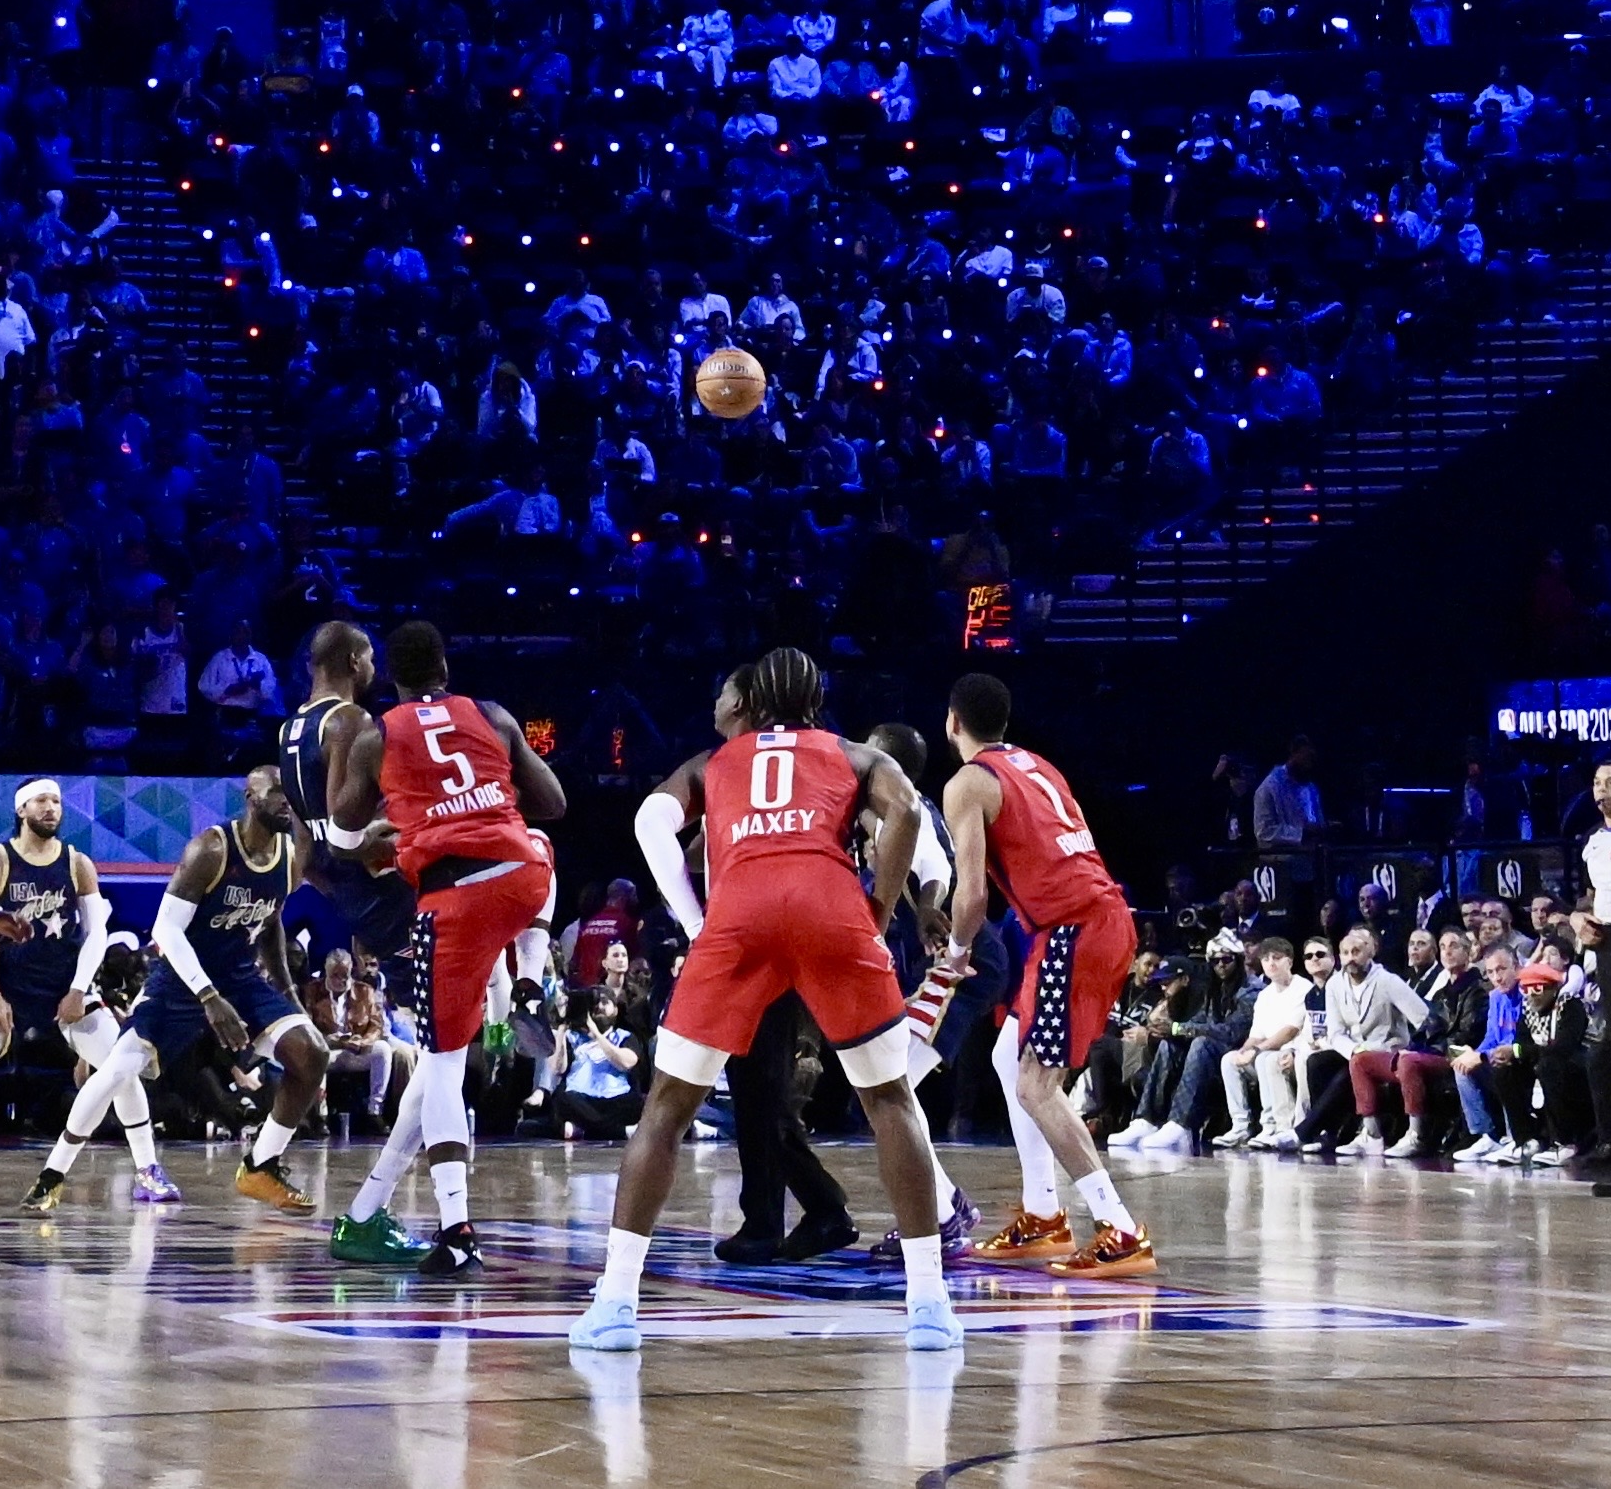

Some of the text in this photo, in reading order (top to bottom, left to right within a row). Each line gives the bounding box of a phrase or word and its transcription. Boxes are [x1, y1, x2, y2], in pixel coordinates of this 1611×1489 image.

[287, 746, 308, 818] 7
[424, 725, 476, 795] 5
[750, 750, 795, 810] 0
[730, 810, 816, 845] MAXEY
[1027, 772, 1076, 829] 1
[224, 885, 252, 906] USA
